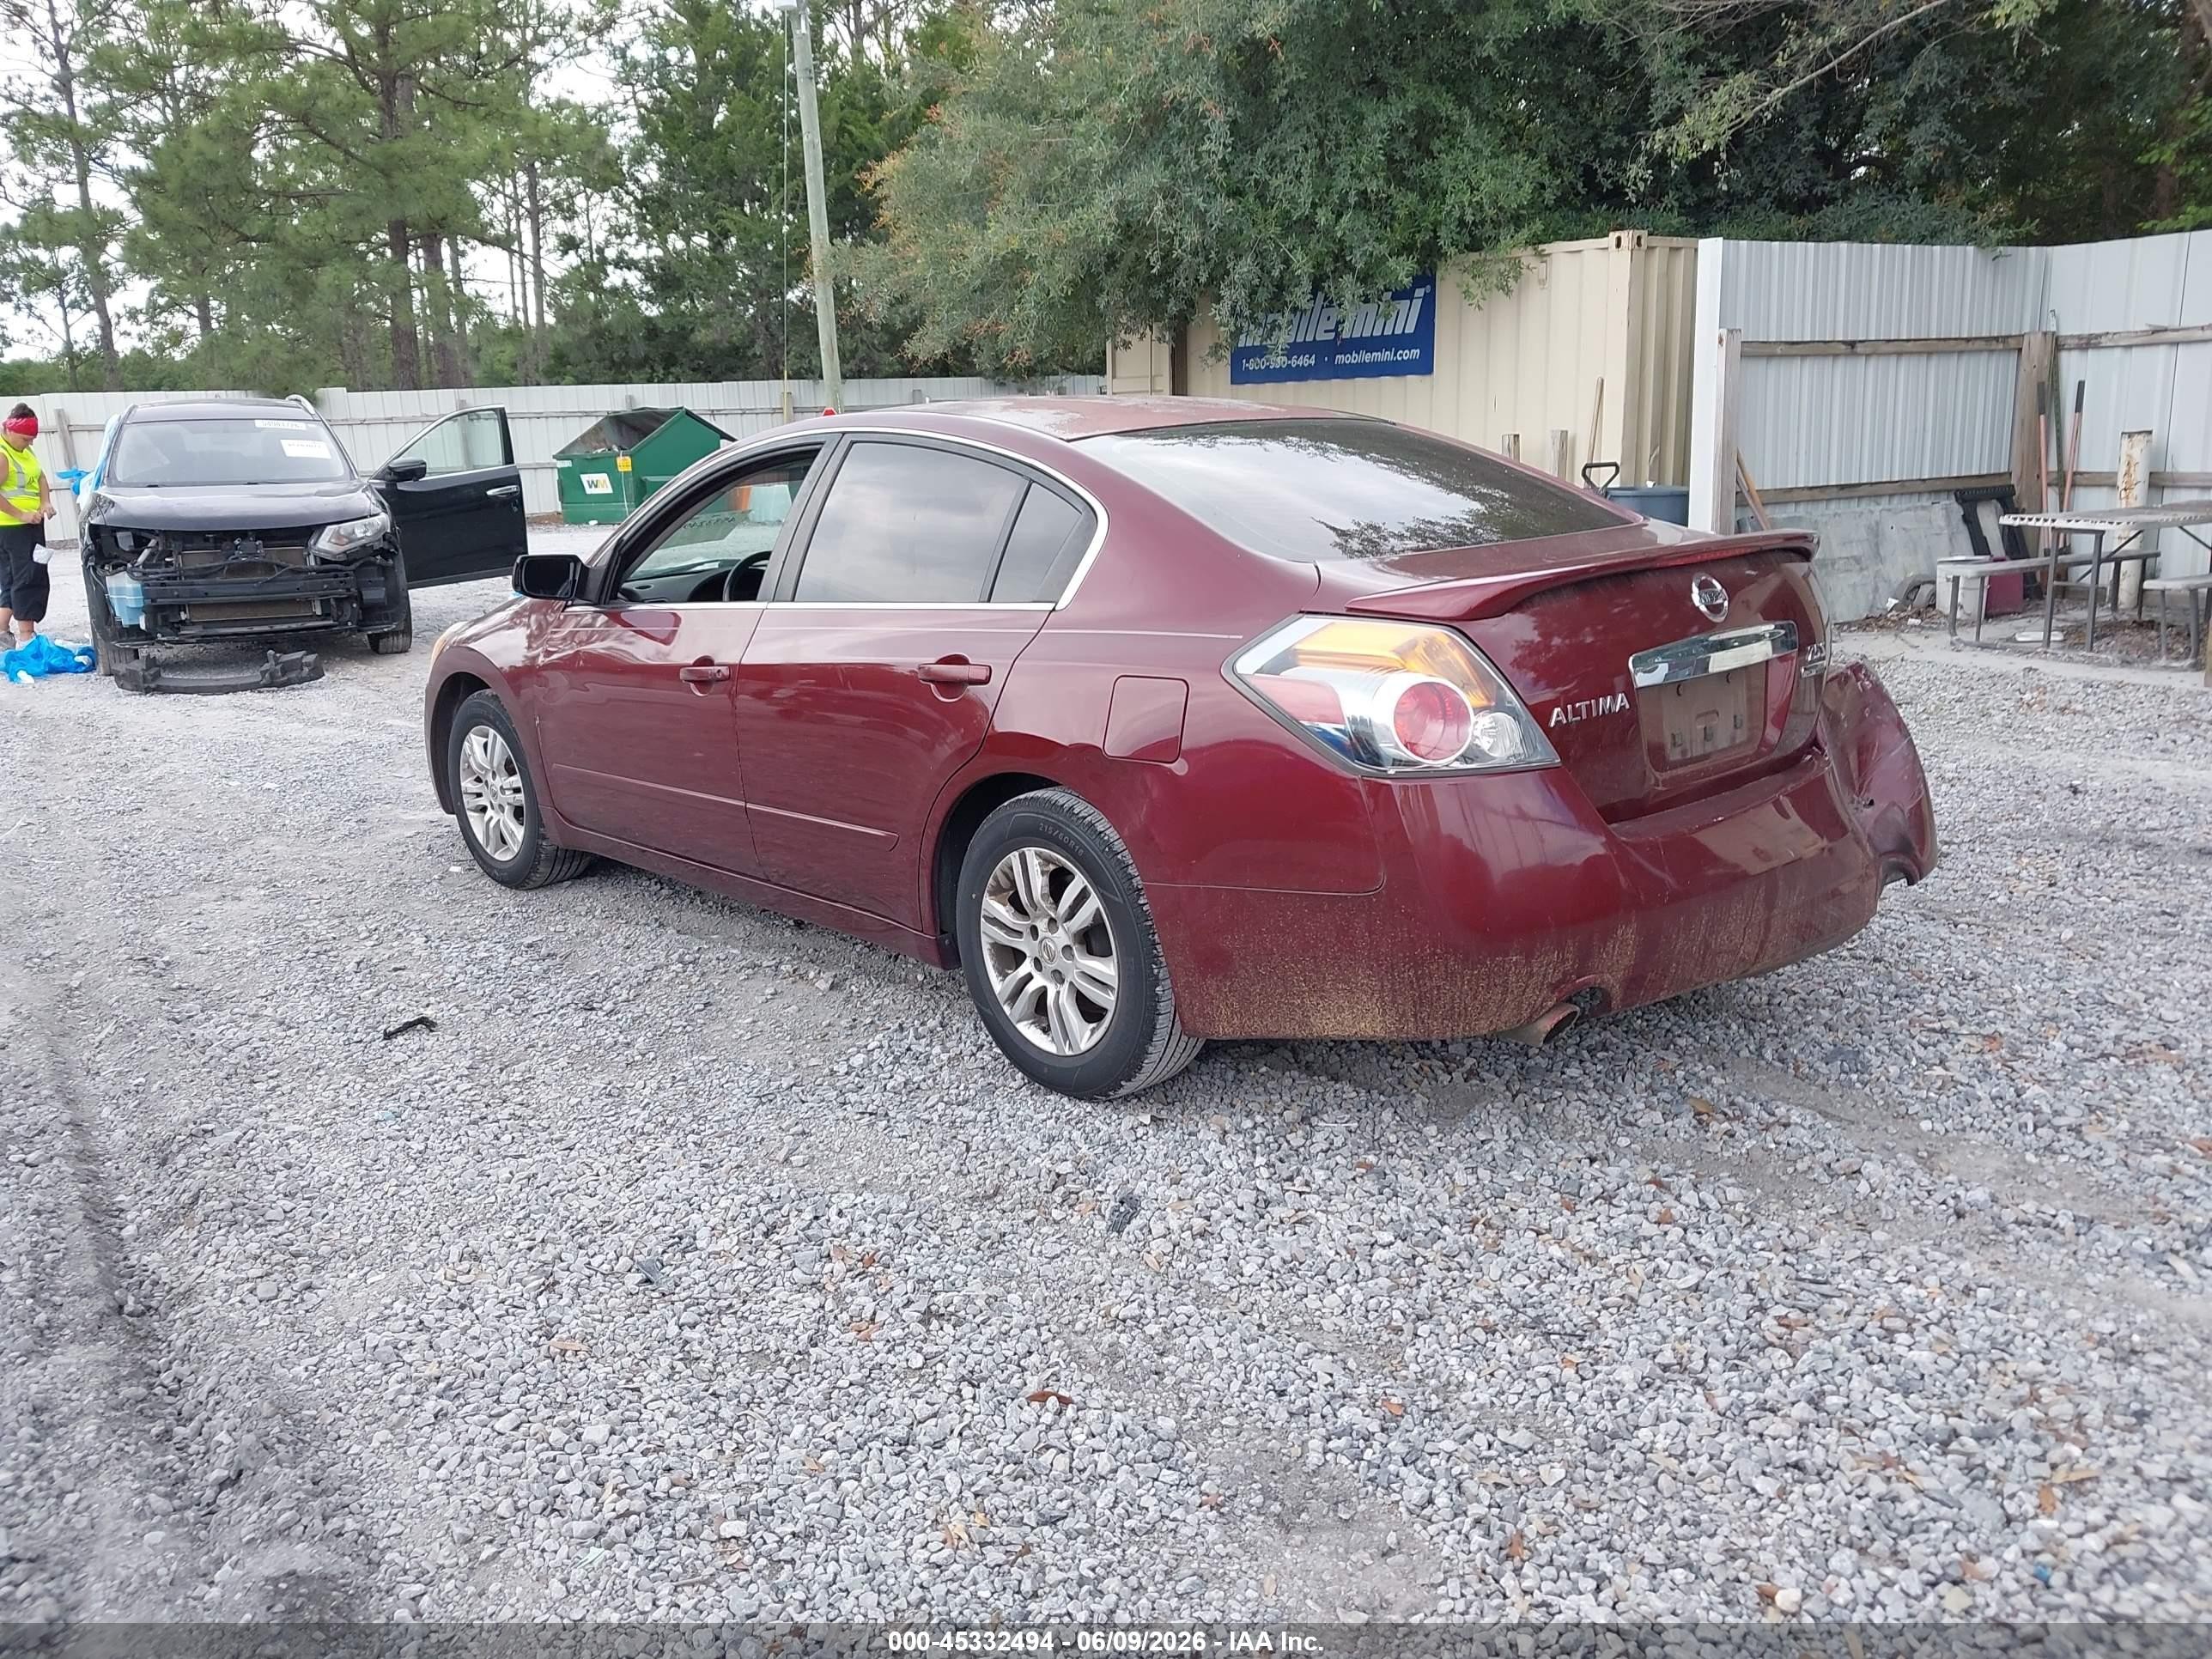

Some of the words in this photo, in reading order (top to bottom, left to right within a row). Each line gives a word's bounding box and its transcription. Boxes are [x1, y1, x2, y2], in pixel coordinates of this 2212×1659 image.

[1334, 347, 1420, 365] mobilemini.com
[586, 479, 608, 489] WM
[1548, 692, 1630, 728] ALTIMA
